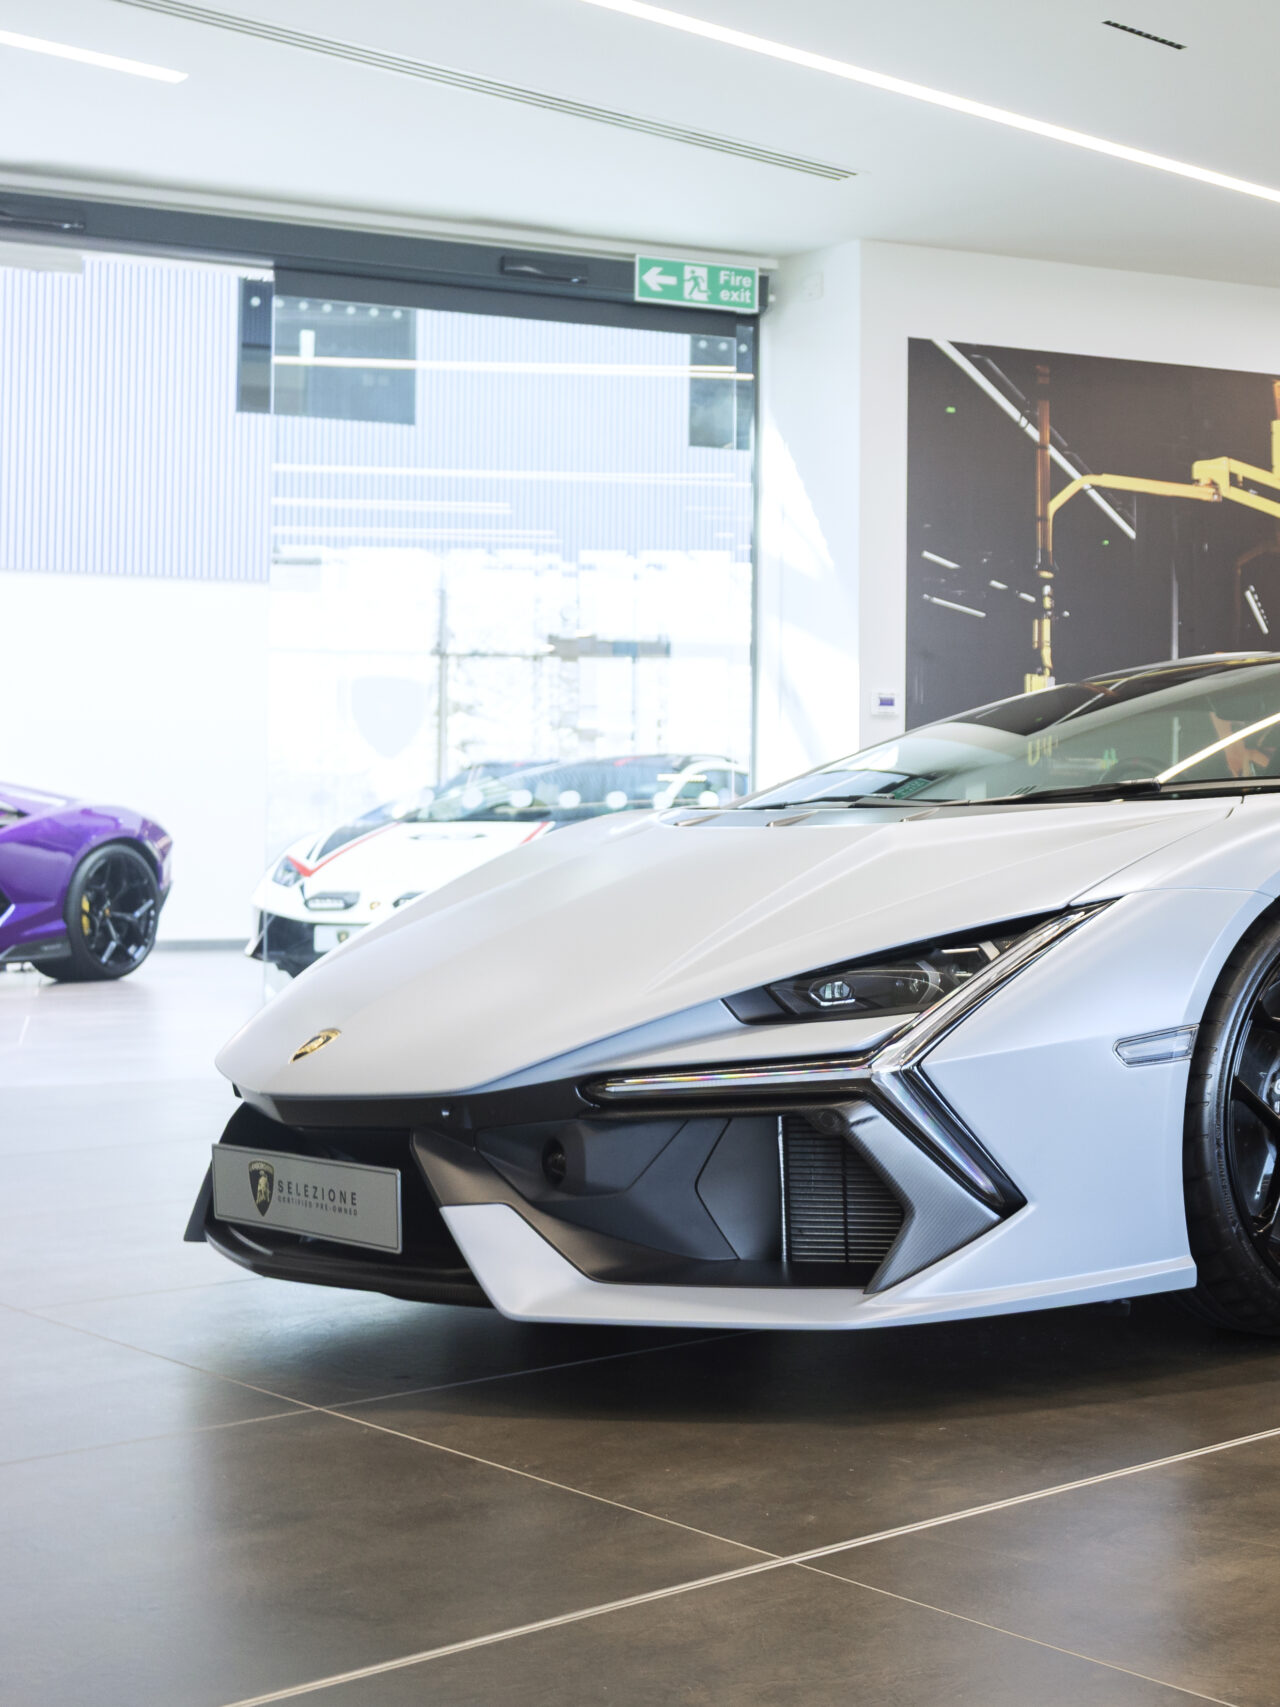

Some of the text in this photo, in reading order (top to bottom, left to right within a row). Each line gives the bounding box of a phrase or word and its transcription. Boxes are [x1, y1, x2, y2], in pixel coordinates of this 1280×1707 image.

[719, 270, 753, 288] Fire
[719, 287, 752, 303] exit
[277, 1179, 358, 1206] SELEZIONE
